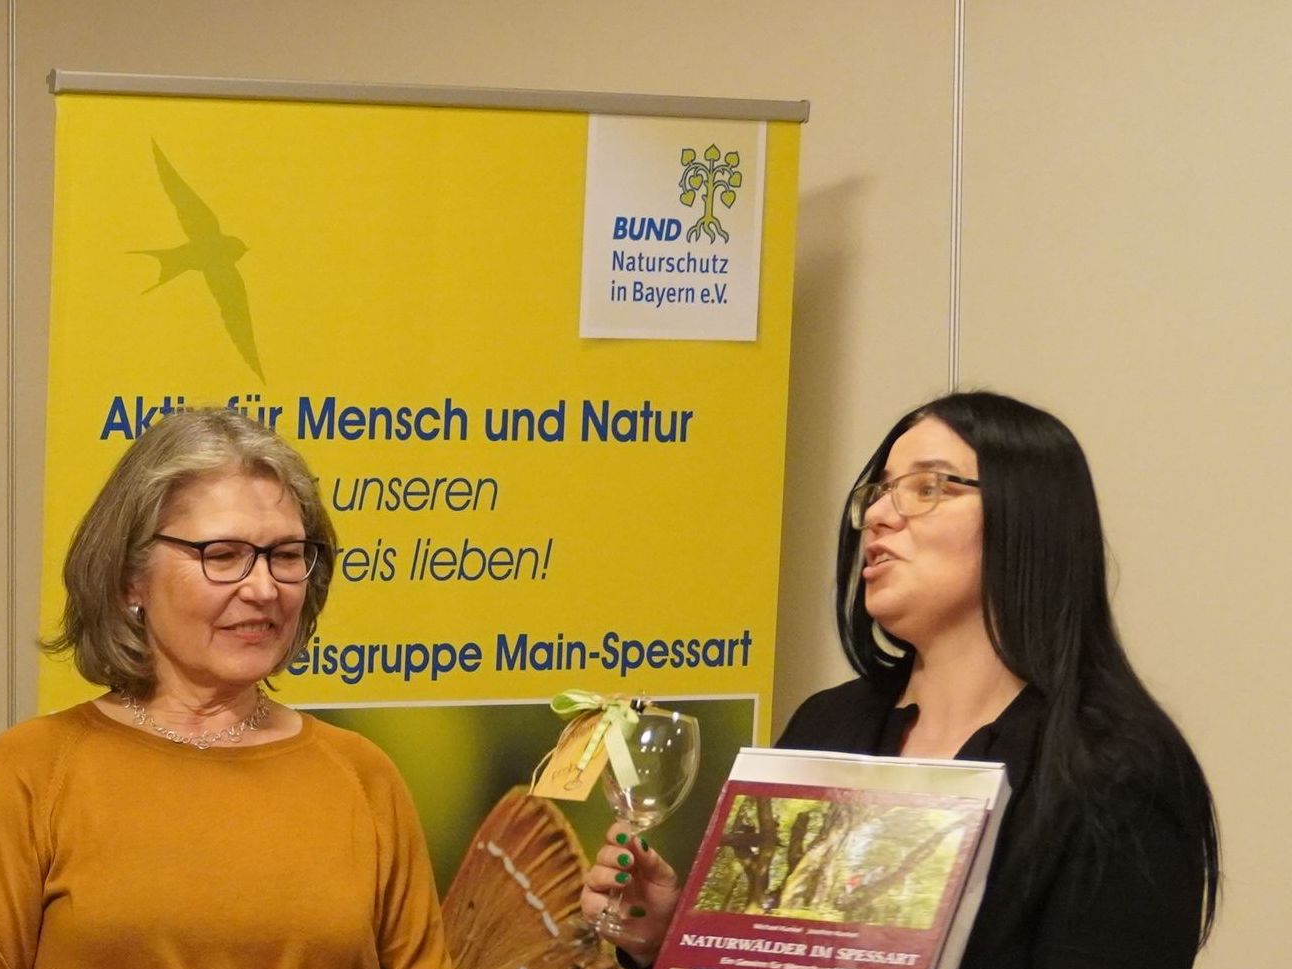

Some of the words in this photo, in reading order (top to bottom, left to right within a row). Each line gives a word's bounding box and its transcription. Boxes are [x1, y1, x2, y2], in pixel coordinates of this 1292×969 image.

[613, 216, 682, 241] BUND
[612, 250, 729, 274] Naturschutz
[611, 280, 627, 301] in
[632, 281, 695, 308] Bayern
[700, 283, 728, 304] e.V.
[297, 396, 468, 441] Mensch
[485, 400, 566, 442] und
[581, 400, 694, 443] Natur
[332, 477, 499, 512] unseren
[410, 538, 553, 581] lieben!
[287, 636, 482, 685] eisgruppe
[495, 630, 752, 678] Main-Spessart
[809, 945, 833, 959] IM
[834, 948, 921, 966] SPESSART
